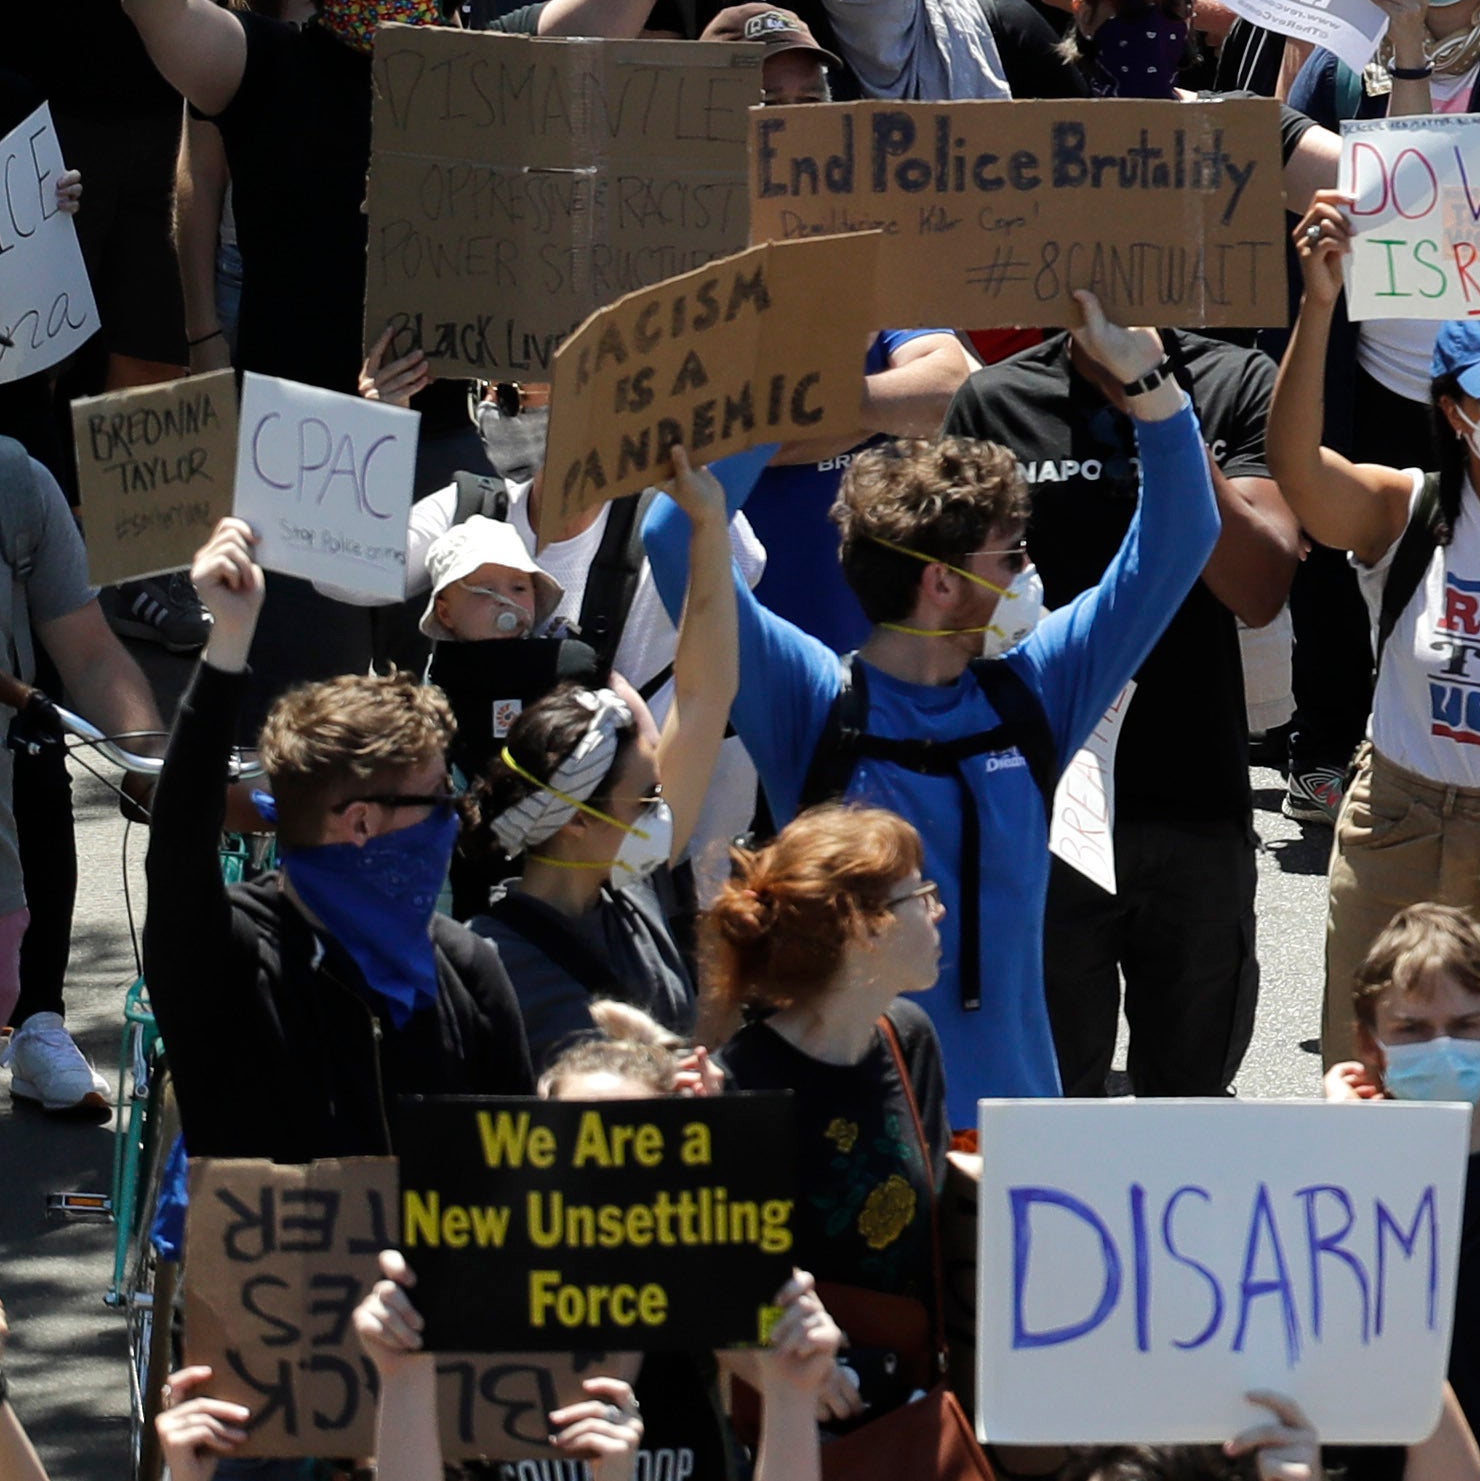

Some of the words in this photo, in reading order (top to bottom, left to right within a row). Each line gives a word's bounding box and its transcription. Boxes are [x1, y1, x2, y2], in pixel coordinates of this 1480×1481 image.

[758, 117, 856, 198] End
[870, 110, 1043, 196] Police
[1052, 122, 1257, 227] Brutality
[1350, 142, 1438, 220] DO
[1365, 238, 1448, 299] IS
[614, 367, 654, 415] IS
[670, 350, 709, 396] A
[110, 447, 212, 497] TAYLOR
[251, 412, 398, 520] CPAC
[477, 1111, 556, 1168] We
[573, 1110, 665, 1168] Are
[681, 1122, 712, 1165] a
[404, 1189, 510, 1250] New
[526, 1186, 795, 1255] Unsettling
[529, 1269, 669, 1328] Force
[1008, 1181, 1438, 1371] DISARM
